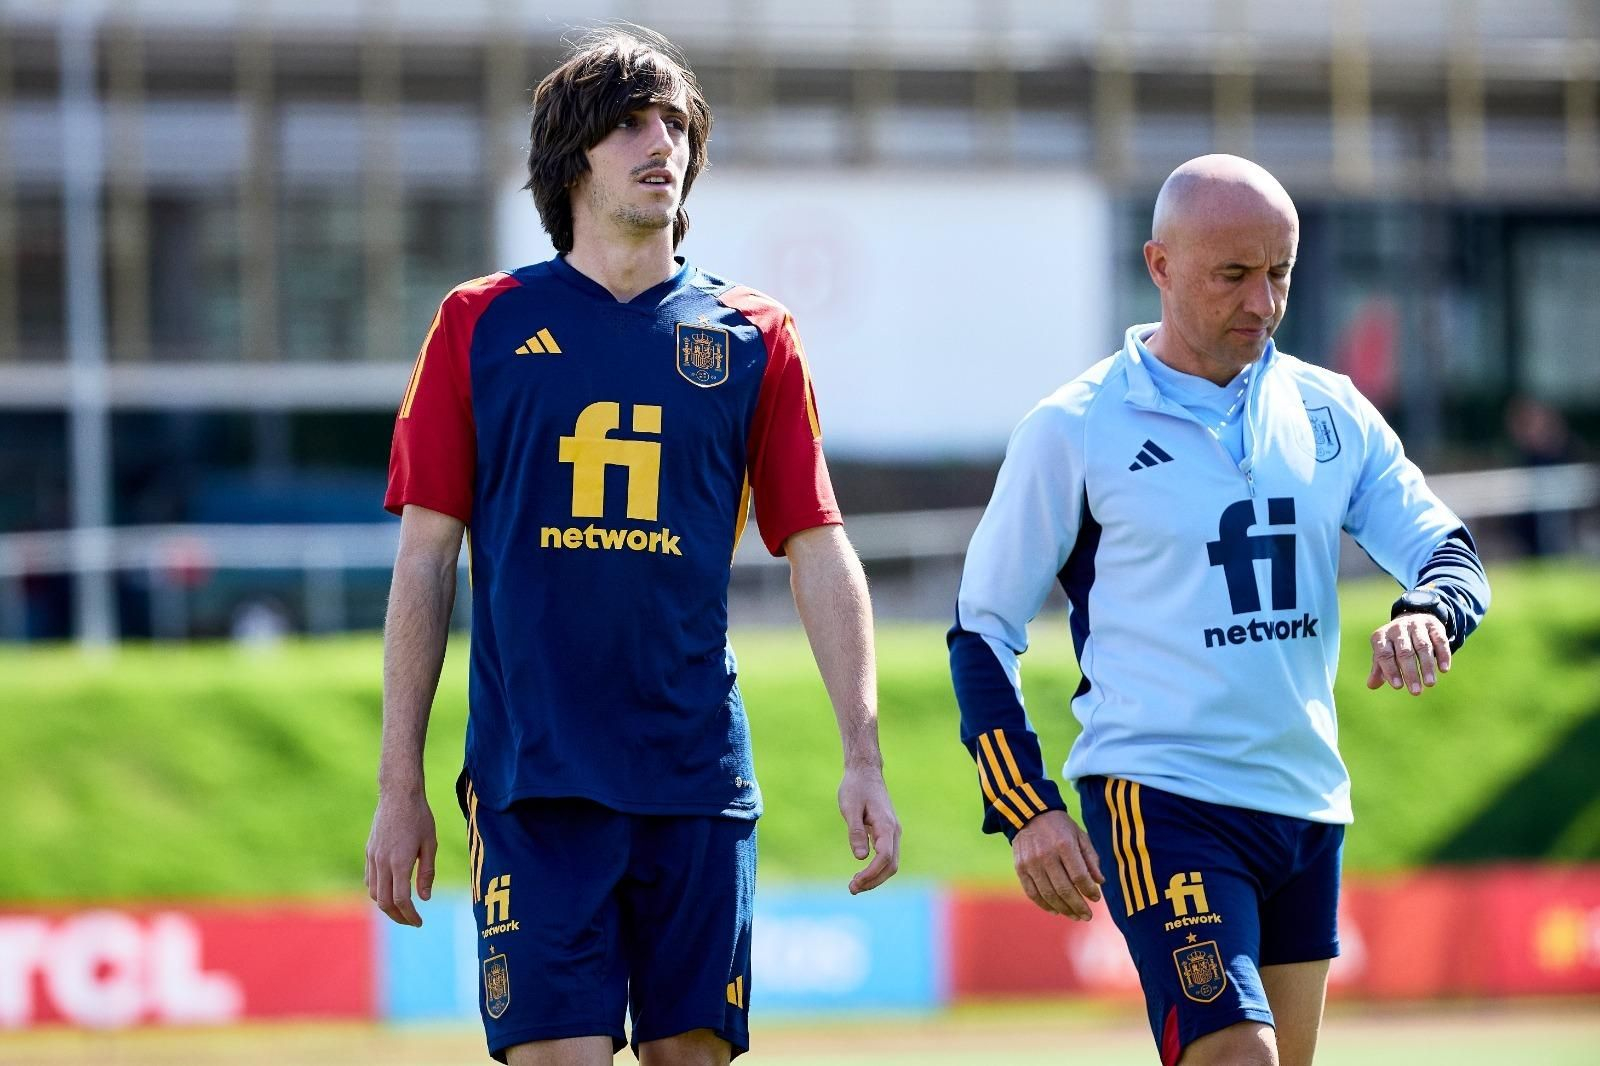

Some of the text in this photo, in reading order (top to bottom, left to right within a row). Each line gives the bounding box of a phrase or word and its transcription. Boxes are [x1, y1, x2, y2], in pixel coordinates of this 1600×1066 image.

[559, 401, 662, 521] fi
[541, 524, 682, 555] network
[1207, 497, 1296, 615] fi
[1204, 613, 1319, 648] network
[485, 875, 511, 926] fi
[1165, 872, 1209, 916] fi
[1165, 913, 1222, 931] network
[0, 911, 245, 1028] TCL
